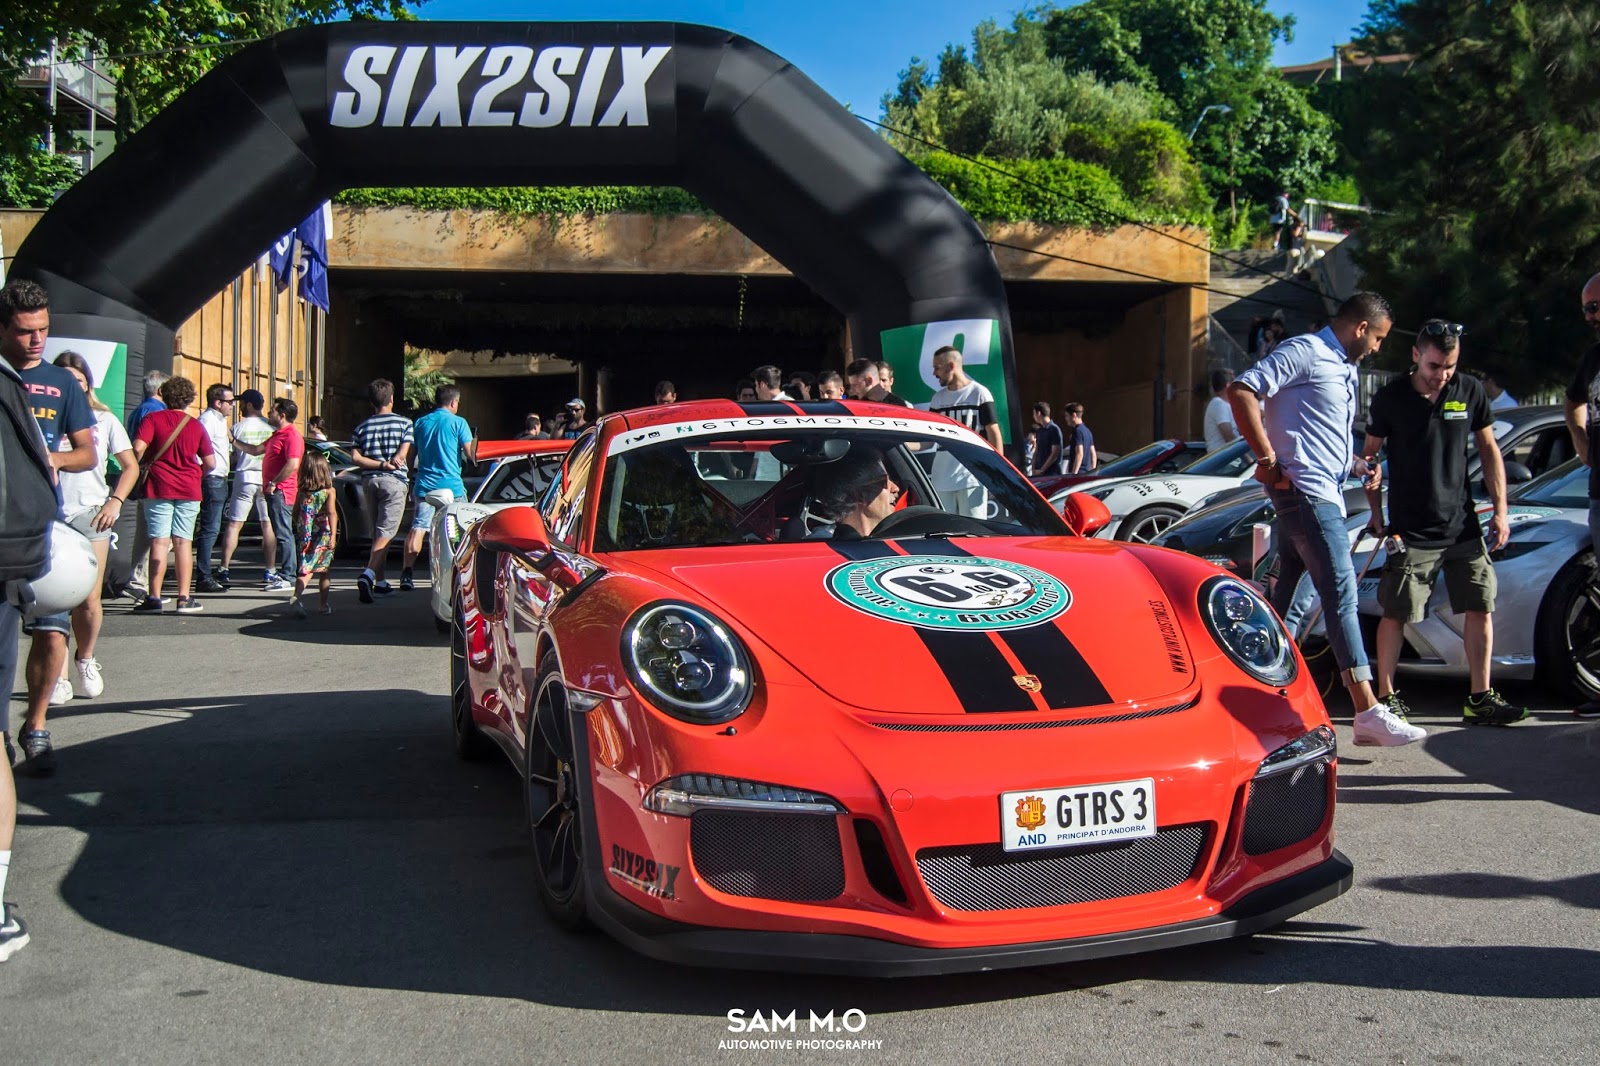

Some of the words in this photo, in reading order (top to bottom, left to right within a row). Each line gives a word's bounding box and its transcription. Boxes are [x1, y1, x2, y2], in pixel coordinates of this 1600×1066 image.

[330, 45, 672, 128] SIX2SIX
[702, 417, 910, 431] 6TO6MOTOR
[1056, 789, 1125, 829] GTRS
[1132, 787, 1147, 821] 3
[1018, 833, 1047, 846] AND
[1057, 830, 1099, 841] PRINCIPAT
[1101, 824, 1147, 836] D'ANDORRA
